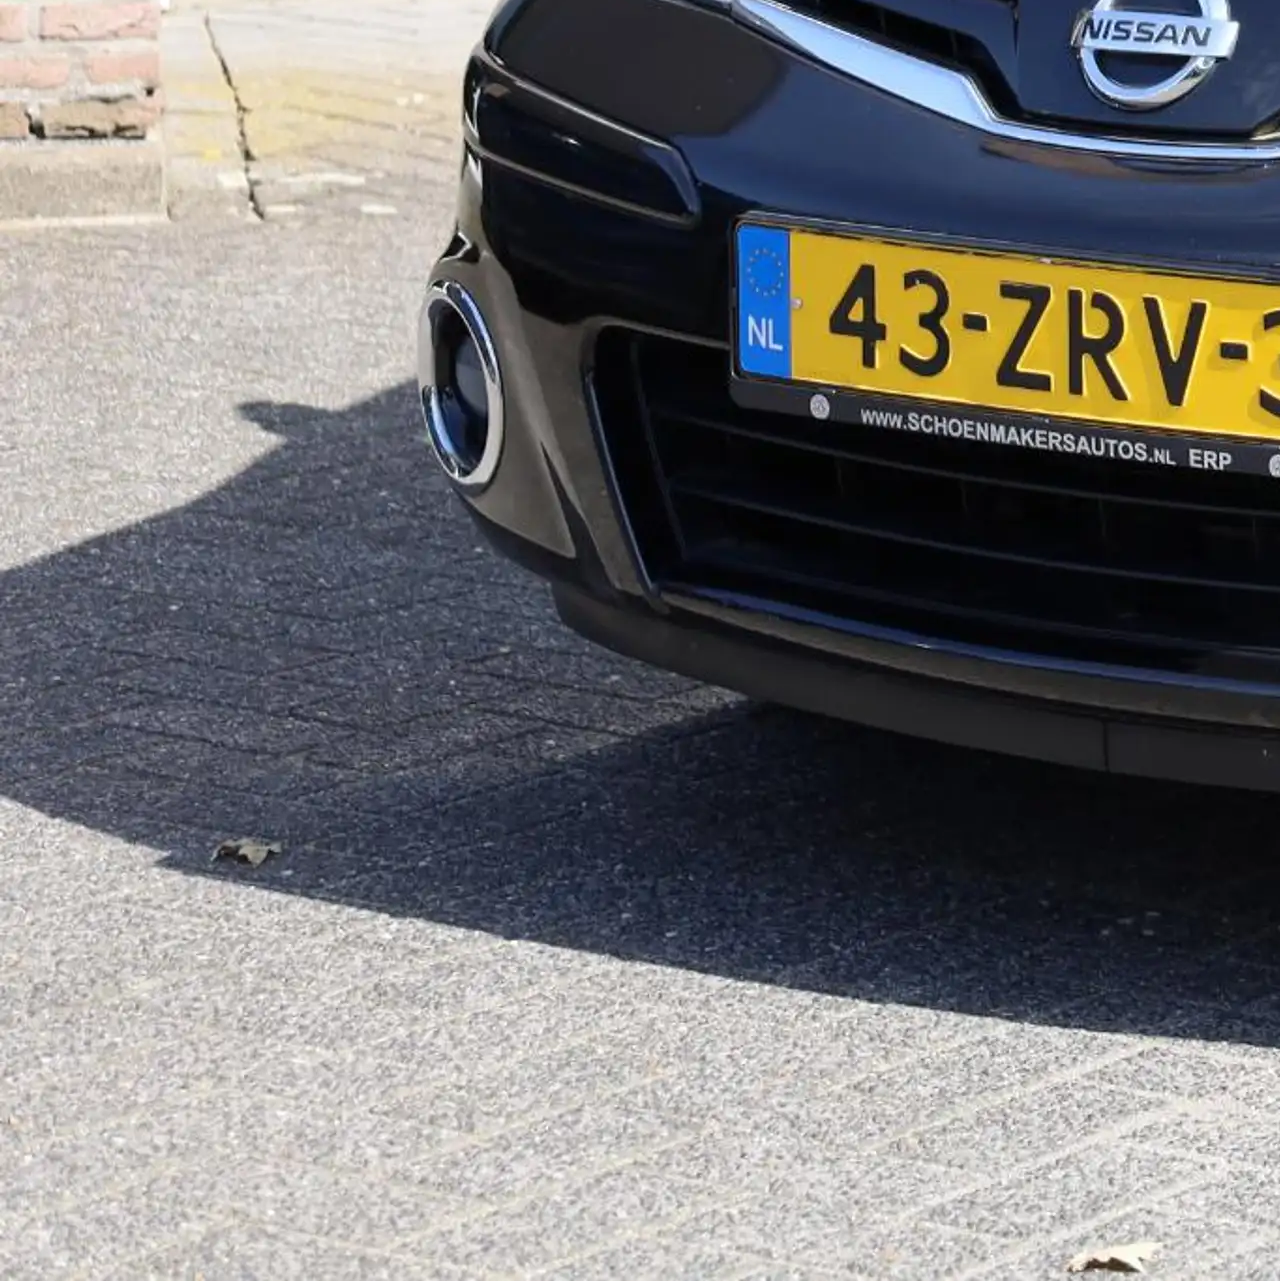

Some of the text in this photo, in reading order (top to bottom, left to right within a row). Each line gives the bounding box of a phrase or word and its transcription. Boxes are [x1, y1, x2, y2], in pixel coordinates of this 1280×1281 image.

[1081, 18, 1212, 47] NISSAN
[748, 314, 783, 351] NL
[1189, 447, 1232, 471] ERP
